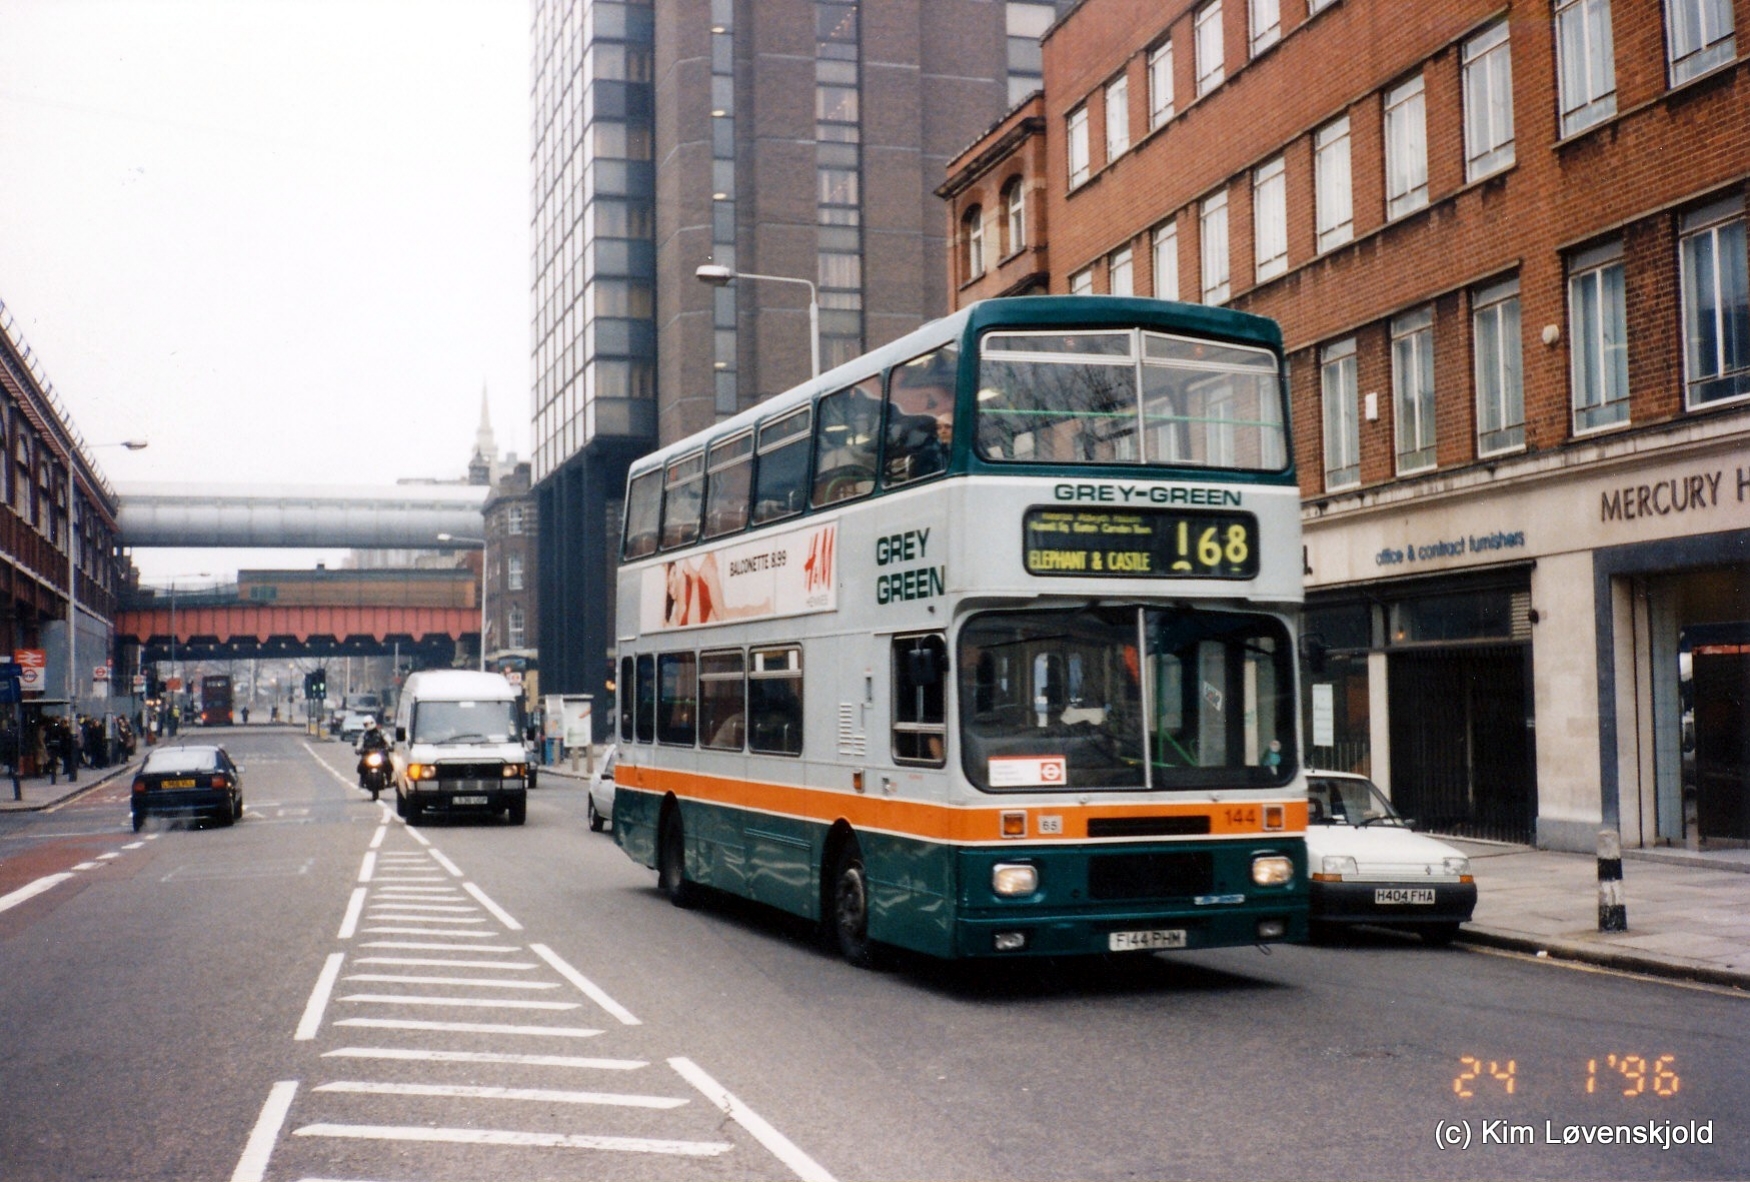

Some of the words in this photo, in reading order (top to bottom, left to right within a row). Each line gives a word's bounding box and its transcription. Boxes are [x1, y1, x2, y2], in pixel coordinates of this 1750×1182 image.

[1054, 484, 1242, 506] GREY-GREEN
[1601, 470, 1722, 522] MERCURY
[876, 527, 930, 566] GREY
[1178, 521, 1249, 567] 168
[1376, 547, 1404, 566] office
[1407, 544, 1416, 561] &
[1418, 536, 1465, 561] contract
[1469, 530, 1525, 554] furnishers
[729, 554, 771, 577] BALCONETTE
[1028, 550, 1087, 570] ELEPHANT
[1091, 552, 1103, 571] &
[1107, 552, 1151, 571] CASTLE
[876, 565, 945, 605] GREEN
[1224, 808, 1256, 825] 144
[1377, 890, 1408, 903] H404
[1411, 890, 1434, 902] FHA
[1116, 933, 1149, 948] F144
[1152, 931, 1181, 946] PHM
